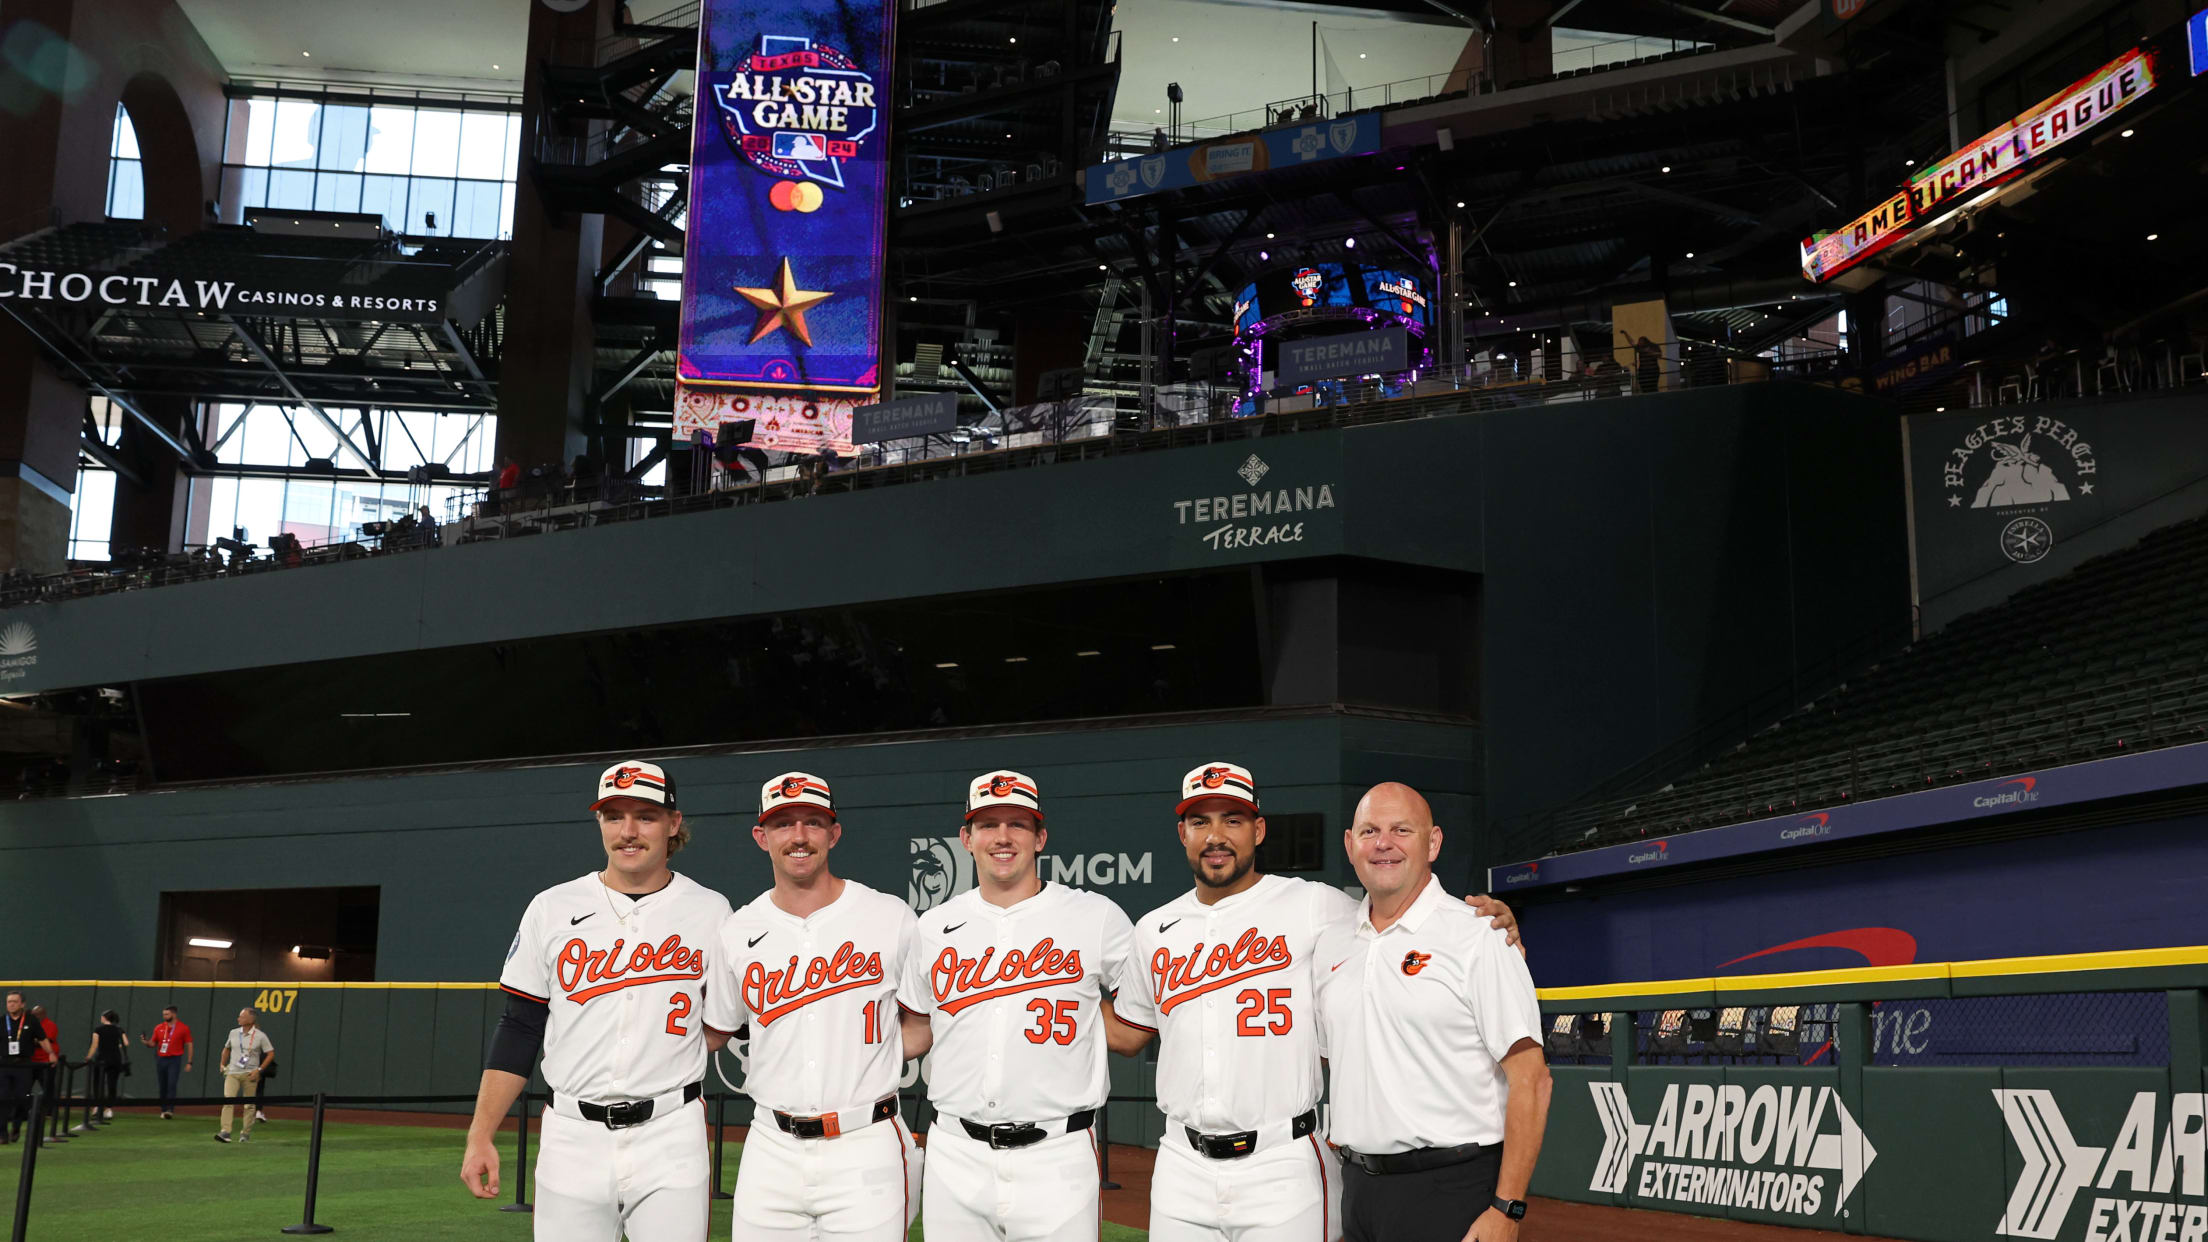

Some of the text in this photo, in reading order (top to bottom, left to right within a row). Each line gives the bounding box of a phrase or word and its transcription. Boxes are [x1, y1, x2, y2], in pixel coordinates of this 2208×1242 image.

[759, 53, 814, 69] TEXAS
[752, 100, 849, 132] GAME
[745, 136, 769, 149] 20
[831, 142, 852, 154] 24
[1208, 146, 1240, 160] BRING
[1853, 67, 2137, 247] AMERICAN LEAGUE
[0, 263, 438, 312] CHOCTAW CASINOS & RESORTS
[1291, 336, 1393, 363] TEREMANA
[1875, 361, 1918, 389] WING
[1919, 344, 1951, 372] BAR
[863, 401, 945, 426] TEREMANA
[1944, 415, 2097, 488] PEAGLE'S PERCH
[1173, 484, 1335, 524] TEREMANA
[1202, 522, 1304, 550] TERRACE
[1036, 852, 1153, 886] TMGM
[557, 934, 703, 1000] Orioles
[742, 940, 884, 1021] Orioles
[931, 937, 1084, 1009] Orioles
[1151, 927, 1292, 1010] Orioles
[254, 989, 298, 1013] 407
[665, 991, 692, 1037] 2
[1024, 997, 1080, 1046] 35
[1236, 988, 1293, 1037] 25
[1869, 1008, 1932, 1054] ne
[1644, 1083, 1832, 1168] ARROW
[1637, 1161, 1825, 1216] EXTERMINATORS
